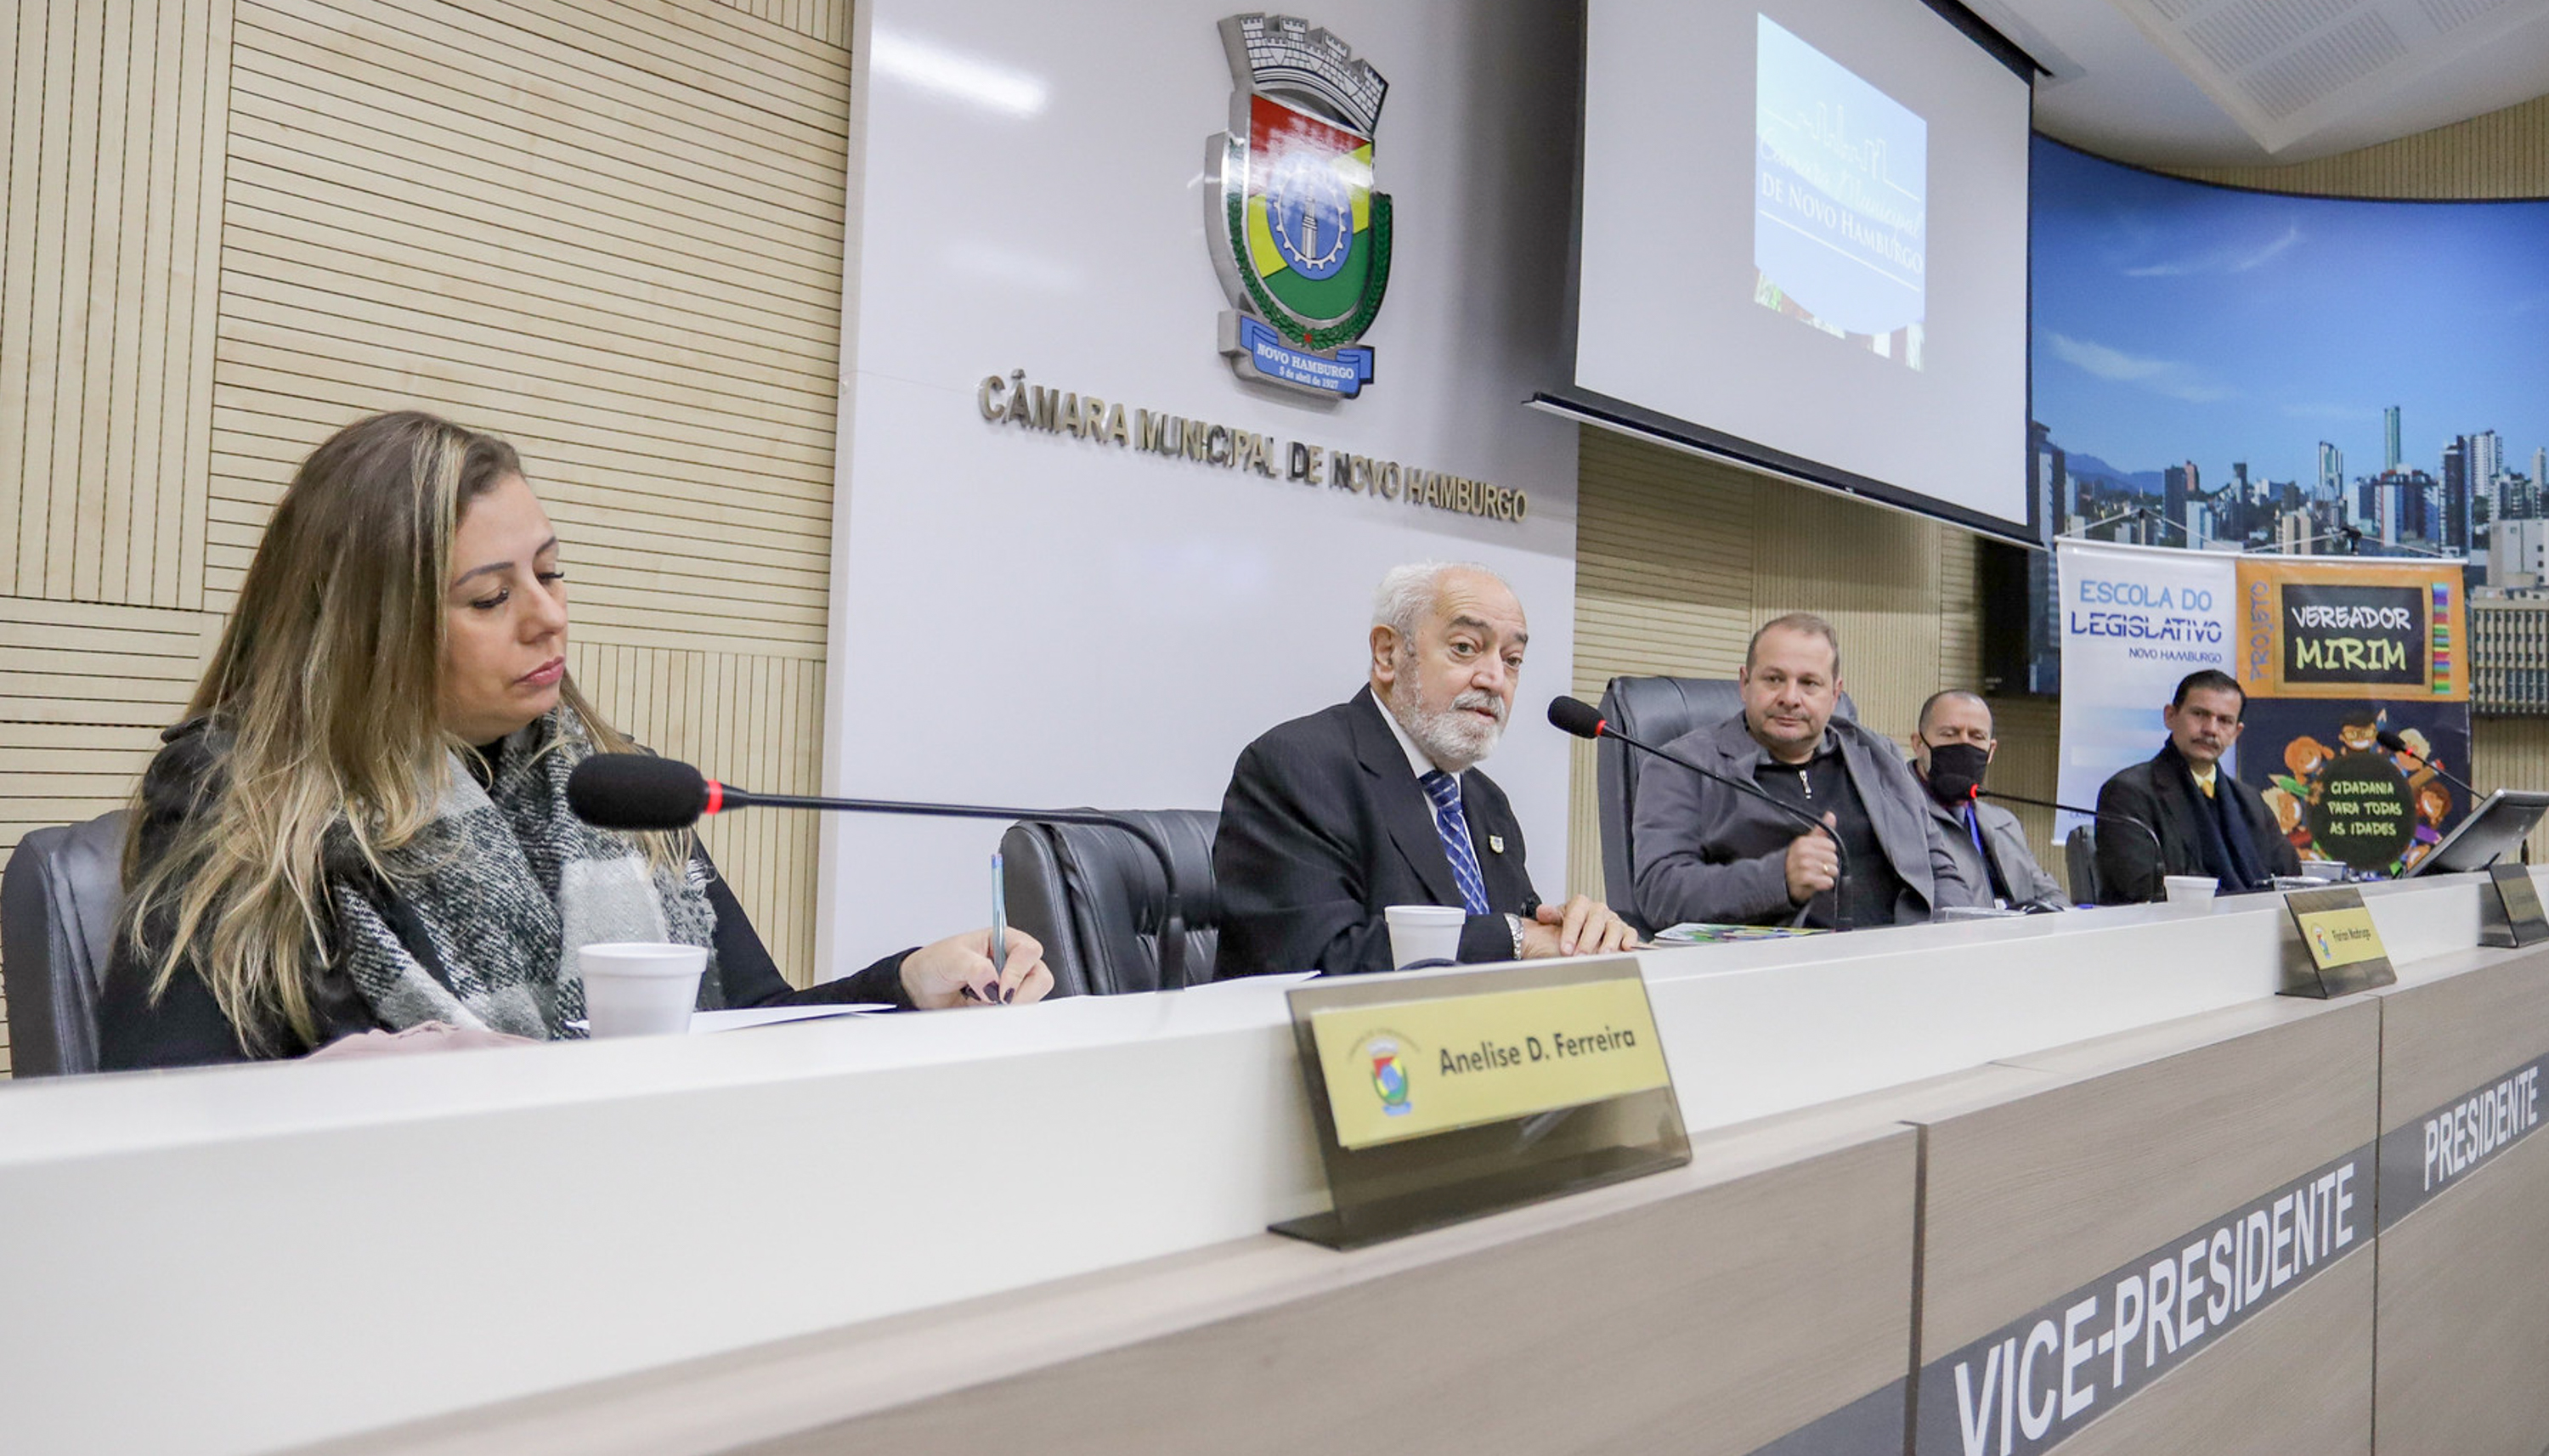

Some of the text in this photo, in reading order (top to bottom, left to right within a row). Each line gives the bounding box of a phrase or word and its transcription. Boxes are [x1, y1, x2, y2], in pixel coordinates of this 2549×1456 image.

[1761, 172, 1784, 204] DE
[1258, 343, 1354, 379] NOVO HAMBURGO
[1286, 369, 1294, 379] de
[1312, 375, 1320, 387] de
[978, 368, 1529, 523] CÂMARA MUNICIPAL DE NOVO HAMBURGO
[2079, 580, 2213, 612] ESCOLA DO
[2071, 611, 2222, 644] LEGISLATIVO
[2250, 580, 2274, 682] PROJETO
[2292, 605, 2412, 630] VEREADOR
[2128, 647, 2223, 663] NOVO HAMBURGO
[2296, 636, 2406, 671] MIRIM
[2331, 781, 2394, 795] CIDADANIA
[2327, 801, 2403, 815] PARA TODAS
[2330, 821, 2397, 836] AS IDADES
[1439, 1041, 1522, 1076] Anelise
[1526, 1036, 1551, 1062] D.
[1556, 1025, 1636, 1058] Ferreira
[2423, 1065, 2539, 1192] PRESIDENTE
[1955, 1162, 2354, 1456] VICE-PRESIDENTE
